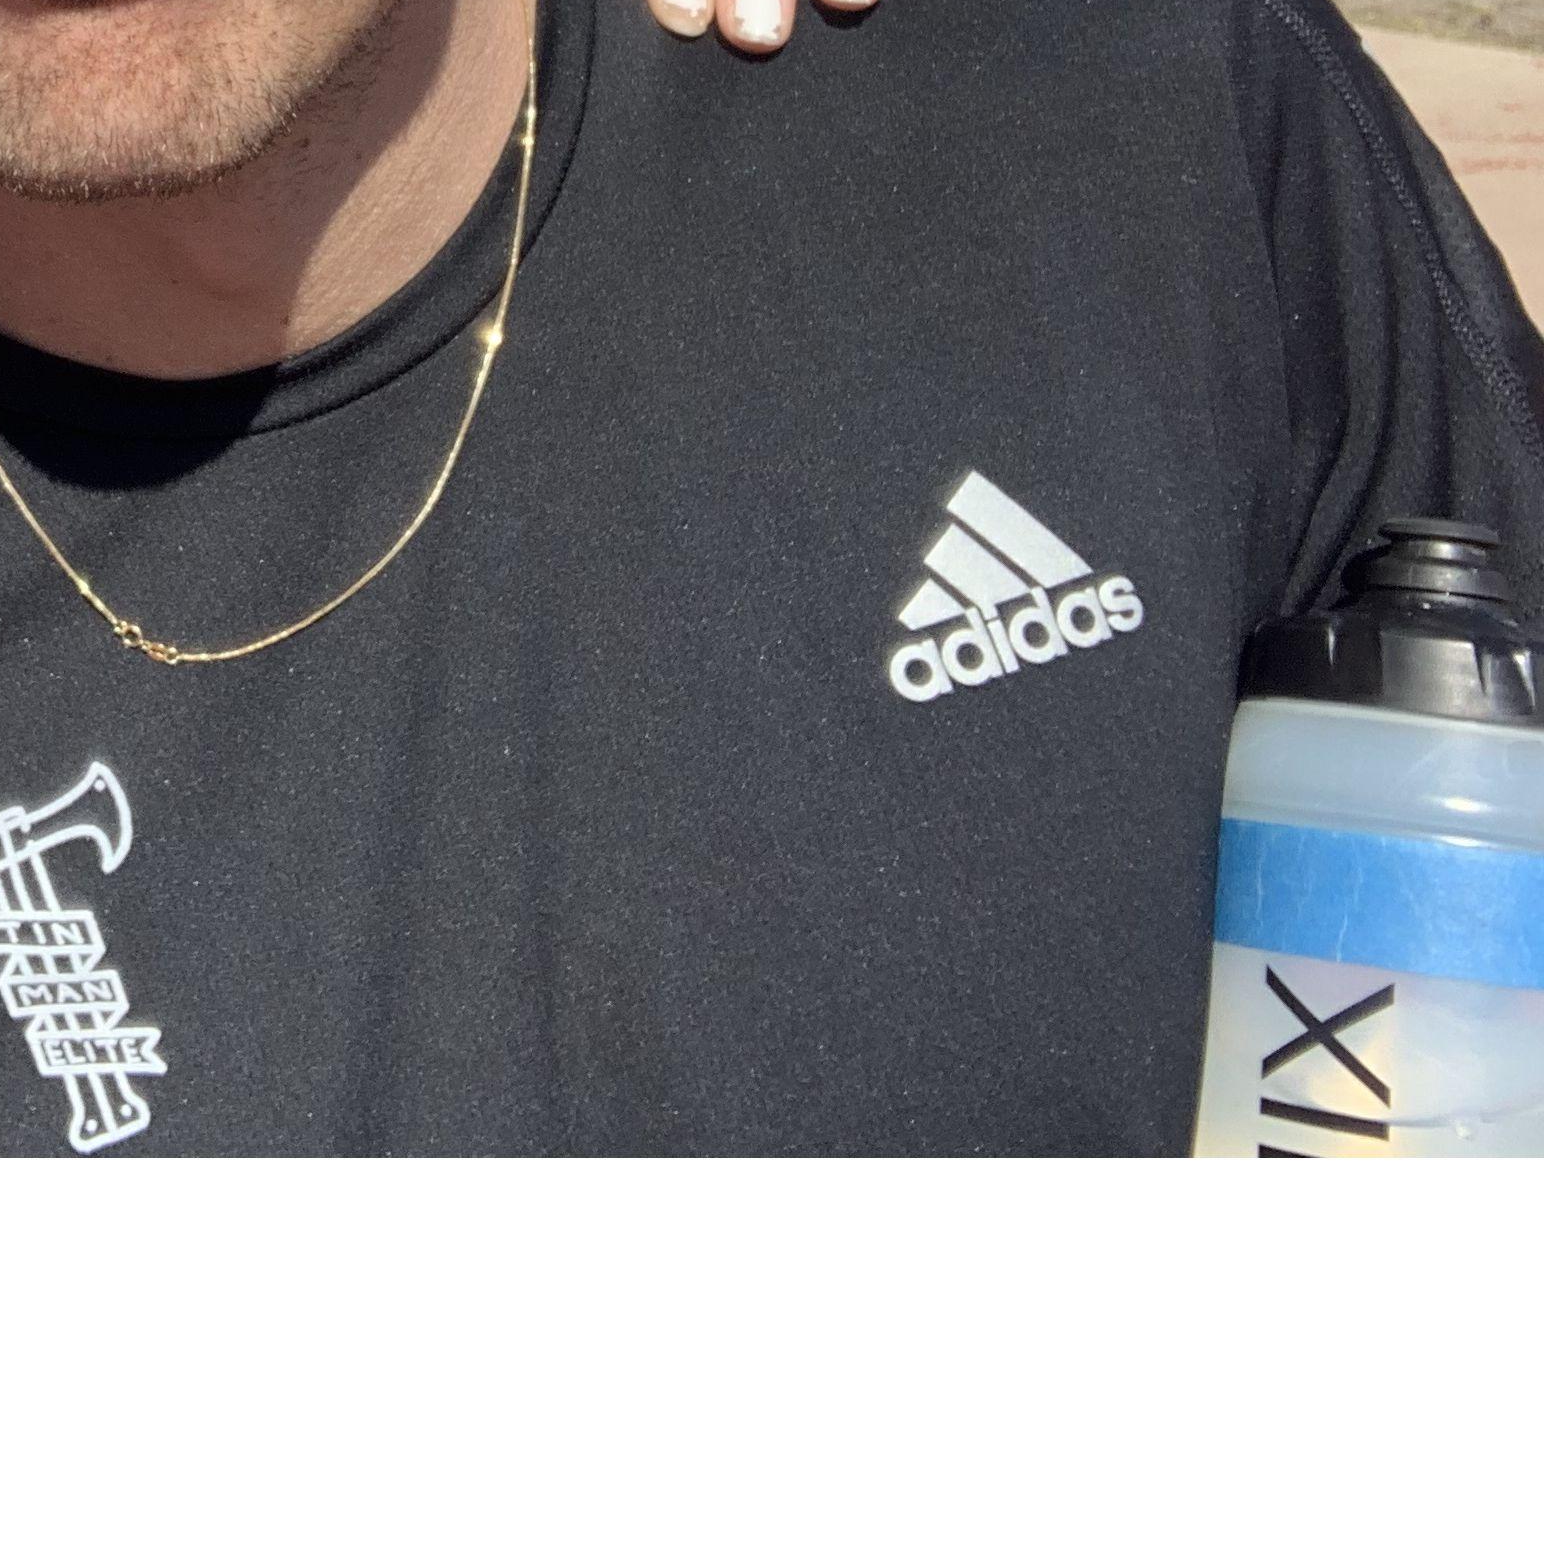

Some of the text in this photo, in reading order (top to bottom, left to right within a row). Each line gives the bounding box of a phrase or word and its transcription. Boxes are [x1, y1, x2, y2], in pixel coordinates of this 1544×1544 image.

[888, 574, 1145, 703] adidas
[16, 979, 114, 1007] MAN
[43, 1037, 144, 1067] ELITE
